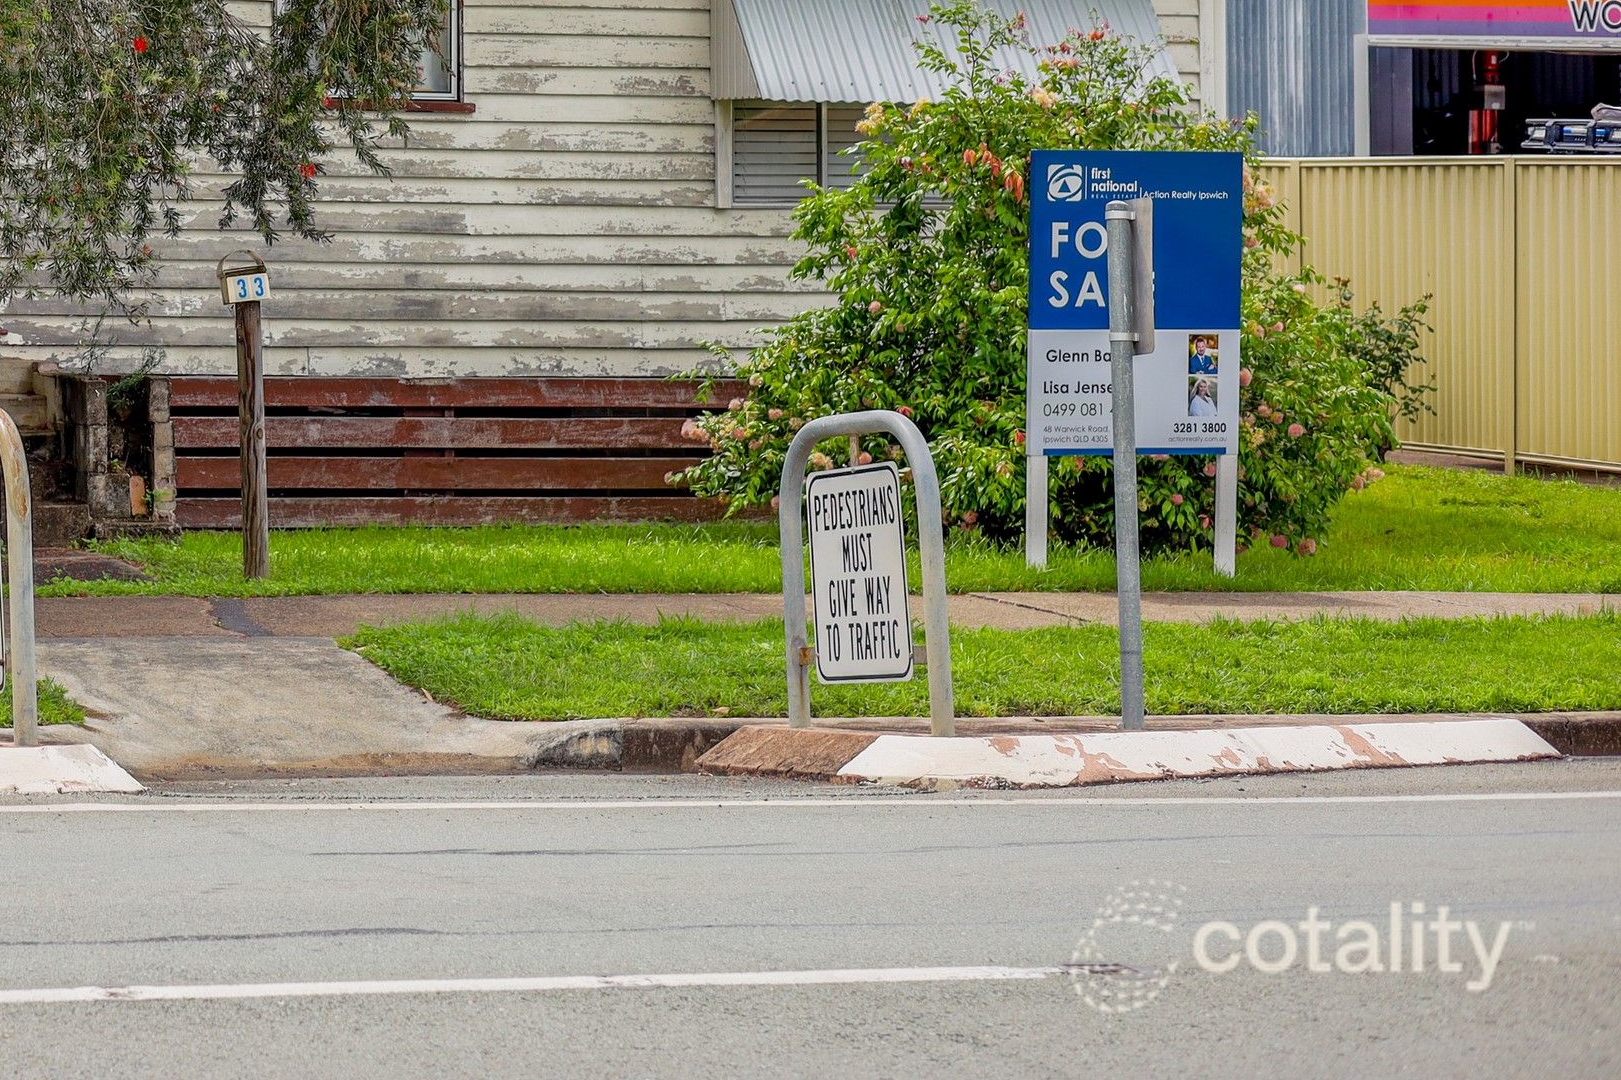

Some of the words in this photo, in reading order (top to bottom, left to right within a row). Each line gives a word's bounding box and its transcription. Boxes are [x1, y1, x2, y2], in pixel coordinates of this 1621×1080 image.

[1091, 167, 1111, 180] first
[1091, 180, 1138, 192] national
[1143, 190, 1170, 200] Action
[1171, 190, 1197, 201] Realty
[1199, 190, 1229, 201] Ipswich
[1051, 221, 1109, 259] FO
[236, 277, 264, 298] 33
[1045, 349, 1090, 363] Glenn
[1094, 349, 1112, 363] Ba
[1043, 381, 1069, 394] Lisa
[1074, 381, 1113, 394] Jense
[1043, 403, 1077, 417] 0499
[1080, 403, 1103, 417] 081
[1054, 425, 1086, 433] Warwick
[1173, 422, 1197, 433] 3281
[1201, 422, 1227, 433] 3800
[814, 485, 896, 532] PEDESTRIANS
[841, 533, 873, 573] MUST
[828, 578, 857, 618] GIVE
[864, 575, 892, 615] WAY
[826, 623, 840, 662] TO
[848, 620, 900, 661] TRAFFIC
